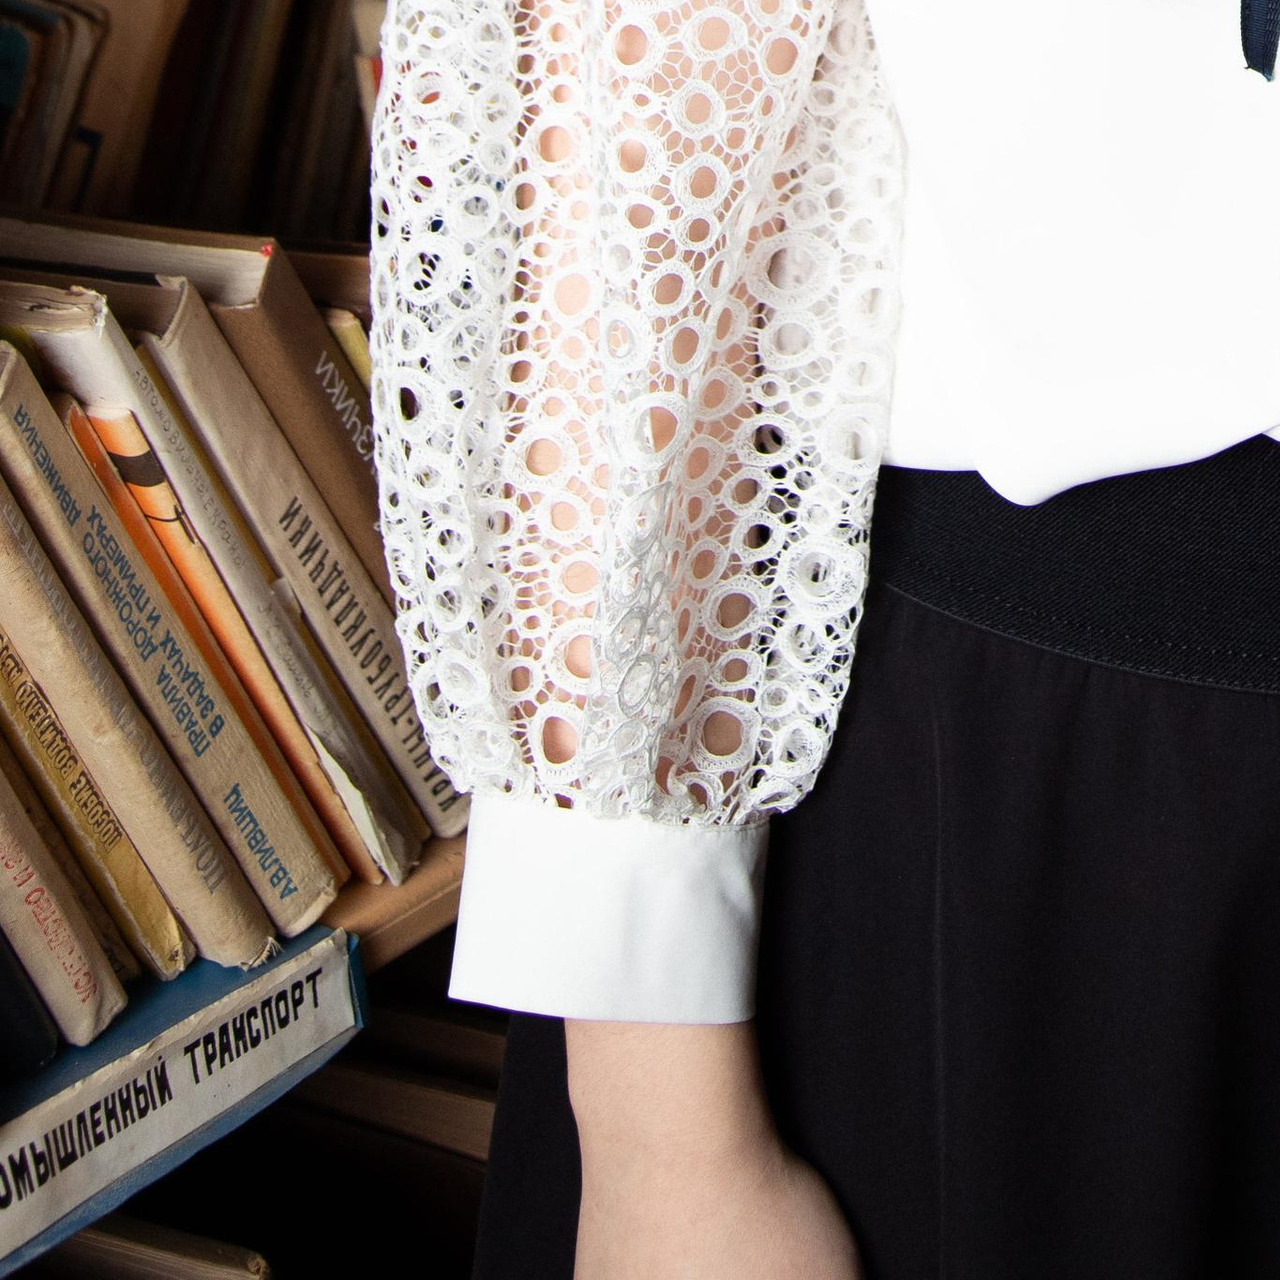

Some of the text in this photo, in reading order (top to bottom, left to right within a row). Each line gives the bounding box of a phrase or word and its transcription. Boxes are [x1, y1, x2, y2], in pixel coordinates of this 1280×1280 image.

[14, 402, 210, 759] ПРАВИЛА ДОРОЖНОГО ДВИЖЕНИЯ
[86, 503, 224, 739] В ЗАДАЧАХ И ПРИМЕРАХ
[16, 680, 79, 781] ВОДИТЕЛЮ
[69, 770, 123, 854] ПОСОБИЕ
[183, 968, 323, 1085] ТРАНСПОРТ
